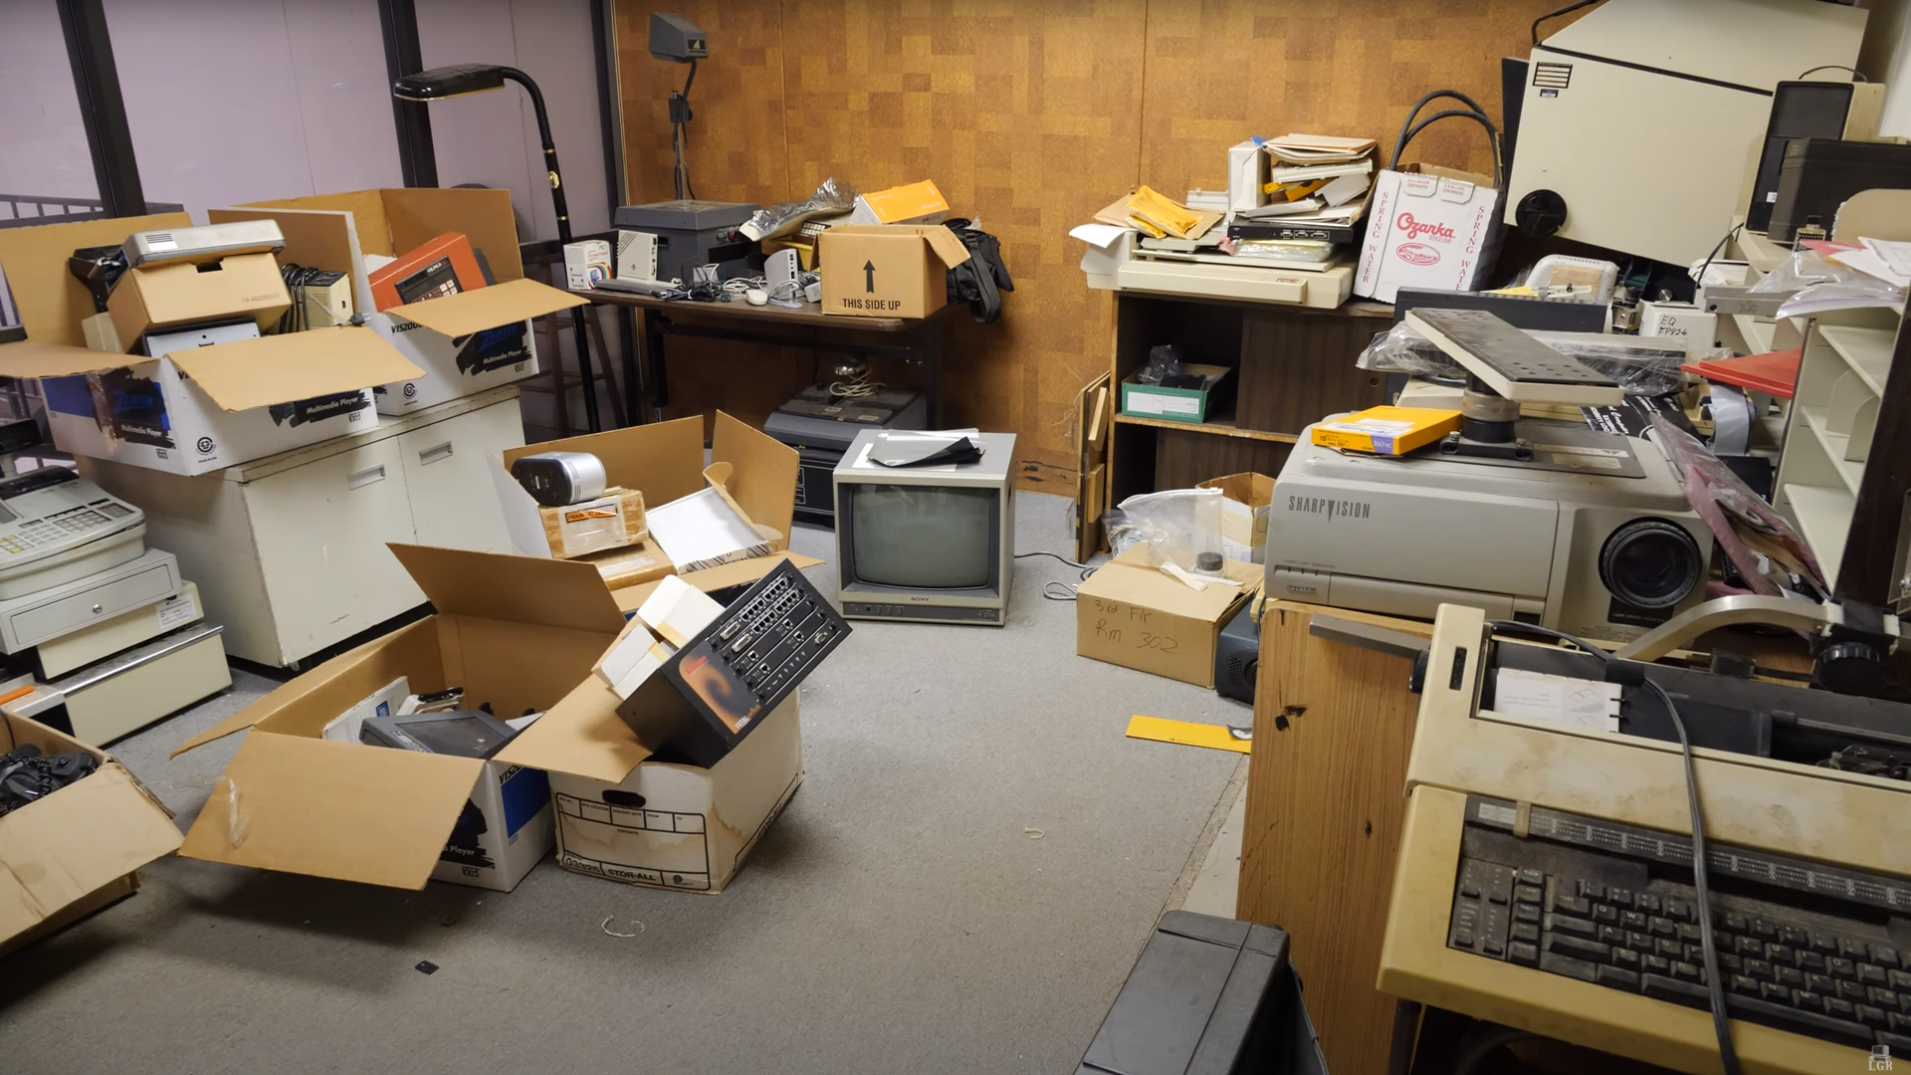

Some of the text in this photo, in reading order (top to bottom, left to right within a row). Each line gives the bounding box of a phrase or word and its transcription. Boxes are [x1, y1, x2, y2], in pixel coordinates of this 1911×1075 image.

[1397, 212, 1455, 240] Ozarka
[1362, 192, 1388, 283] SPRING WATER
[1455, 206, 1485, 290] SPRING WATE
[843, 298, 901, 311] THIS SIDE UP
[391, 322, 423, 334] VIS200
[483, 350, 522, 364] Multimedia Player
[306, 396, 359, 414] Multimedia Player
[146, 428, 162, 438] Player
[1289, 496, 1370, 523] SHARPVISION
[1095, 619, 1179, 655] Rm 302
[450, 845, 475, 857] Player
